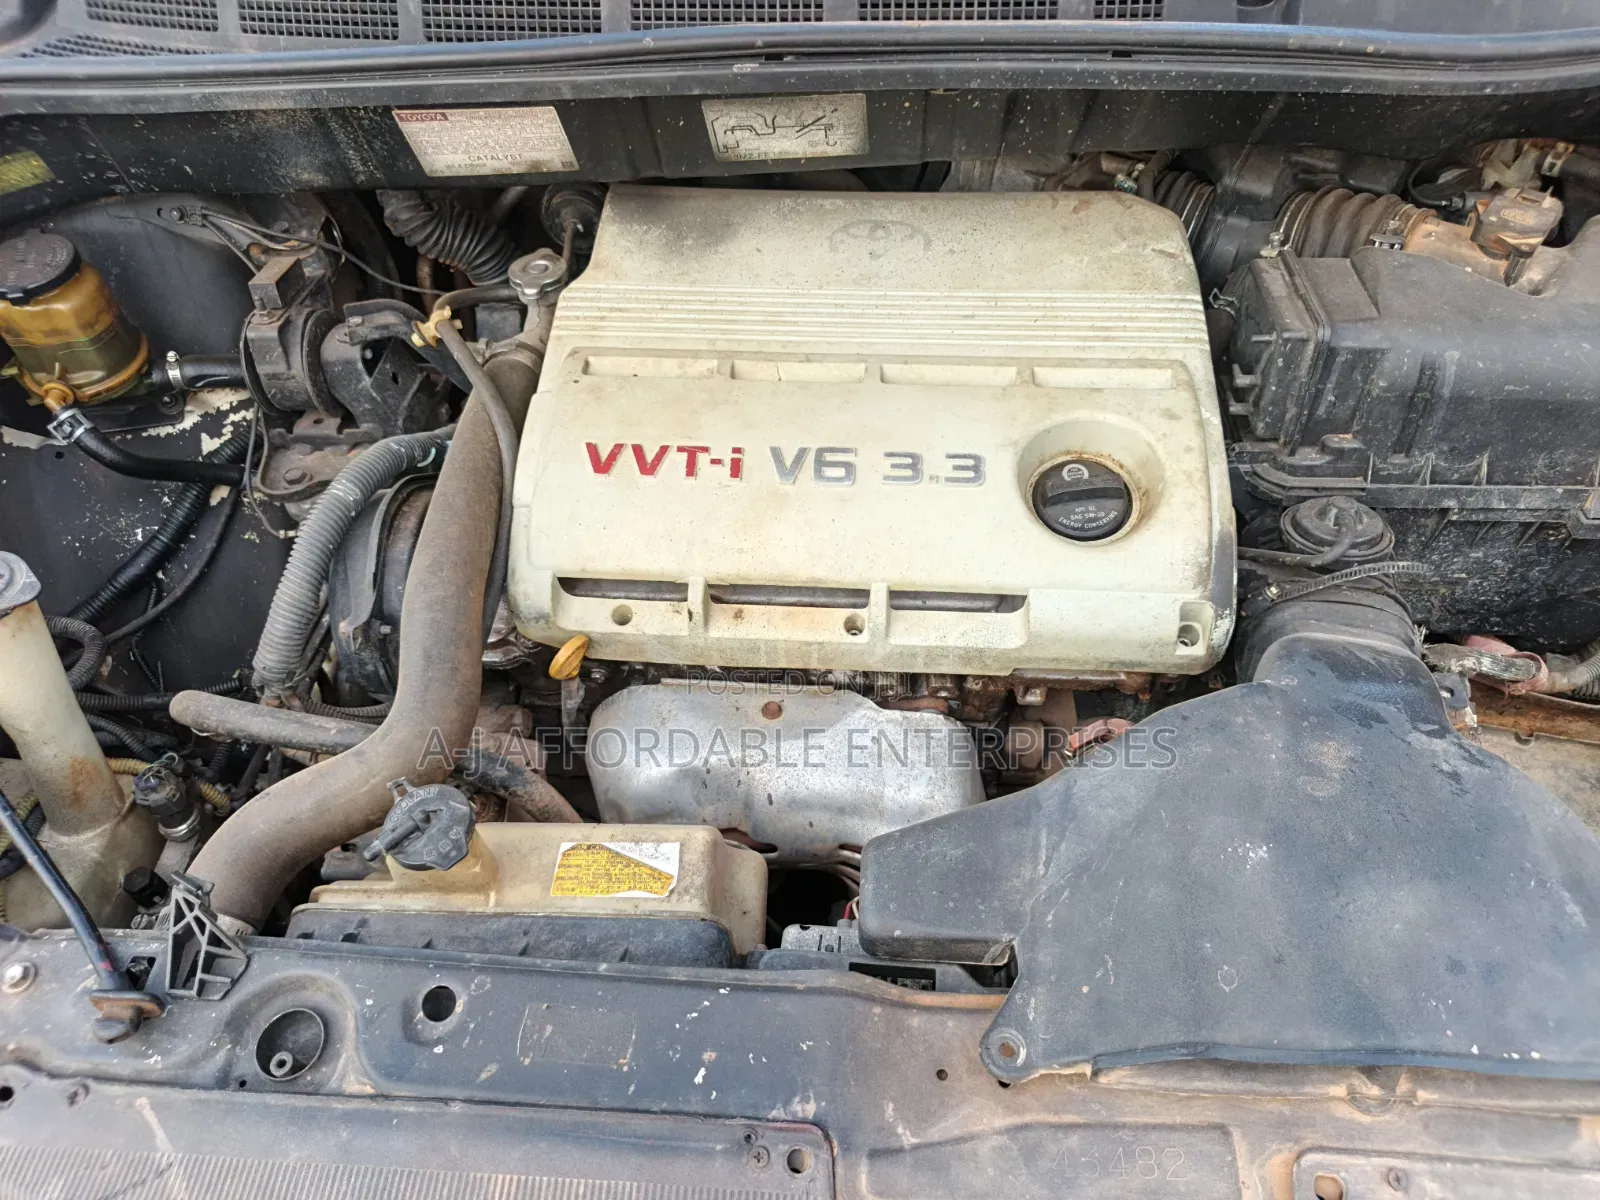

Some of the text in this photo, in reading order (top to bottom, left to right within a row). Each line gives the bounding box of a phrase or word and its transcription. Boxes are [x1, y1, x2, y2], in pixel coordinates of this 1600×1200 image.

[400, 113, 445, 122] TOYOTA
[468, 153, 523, 162] CATALYST
[586, 442, 986, 486] VVT-i V6 3.3
[1058, 510, 1118, 529] ENERGY CONSERVING
